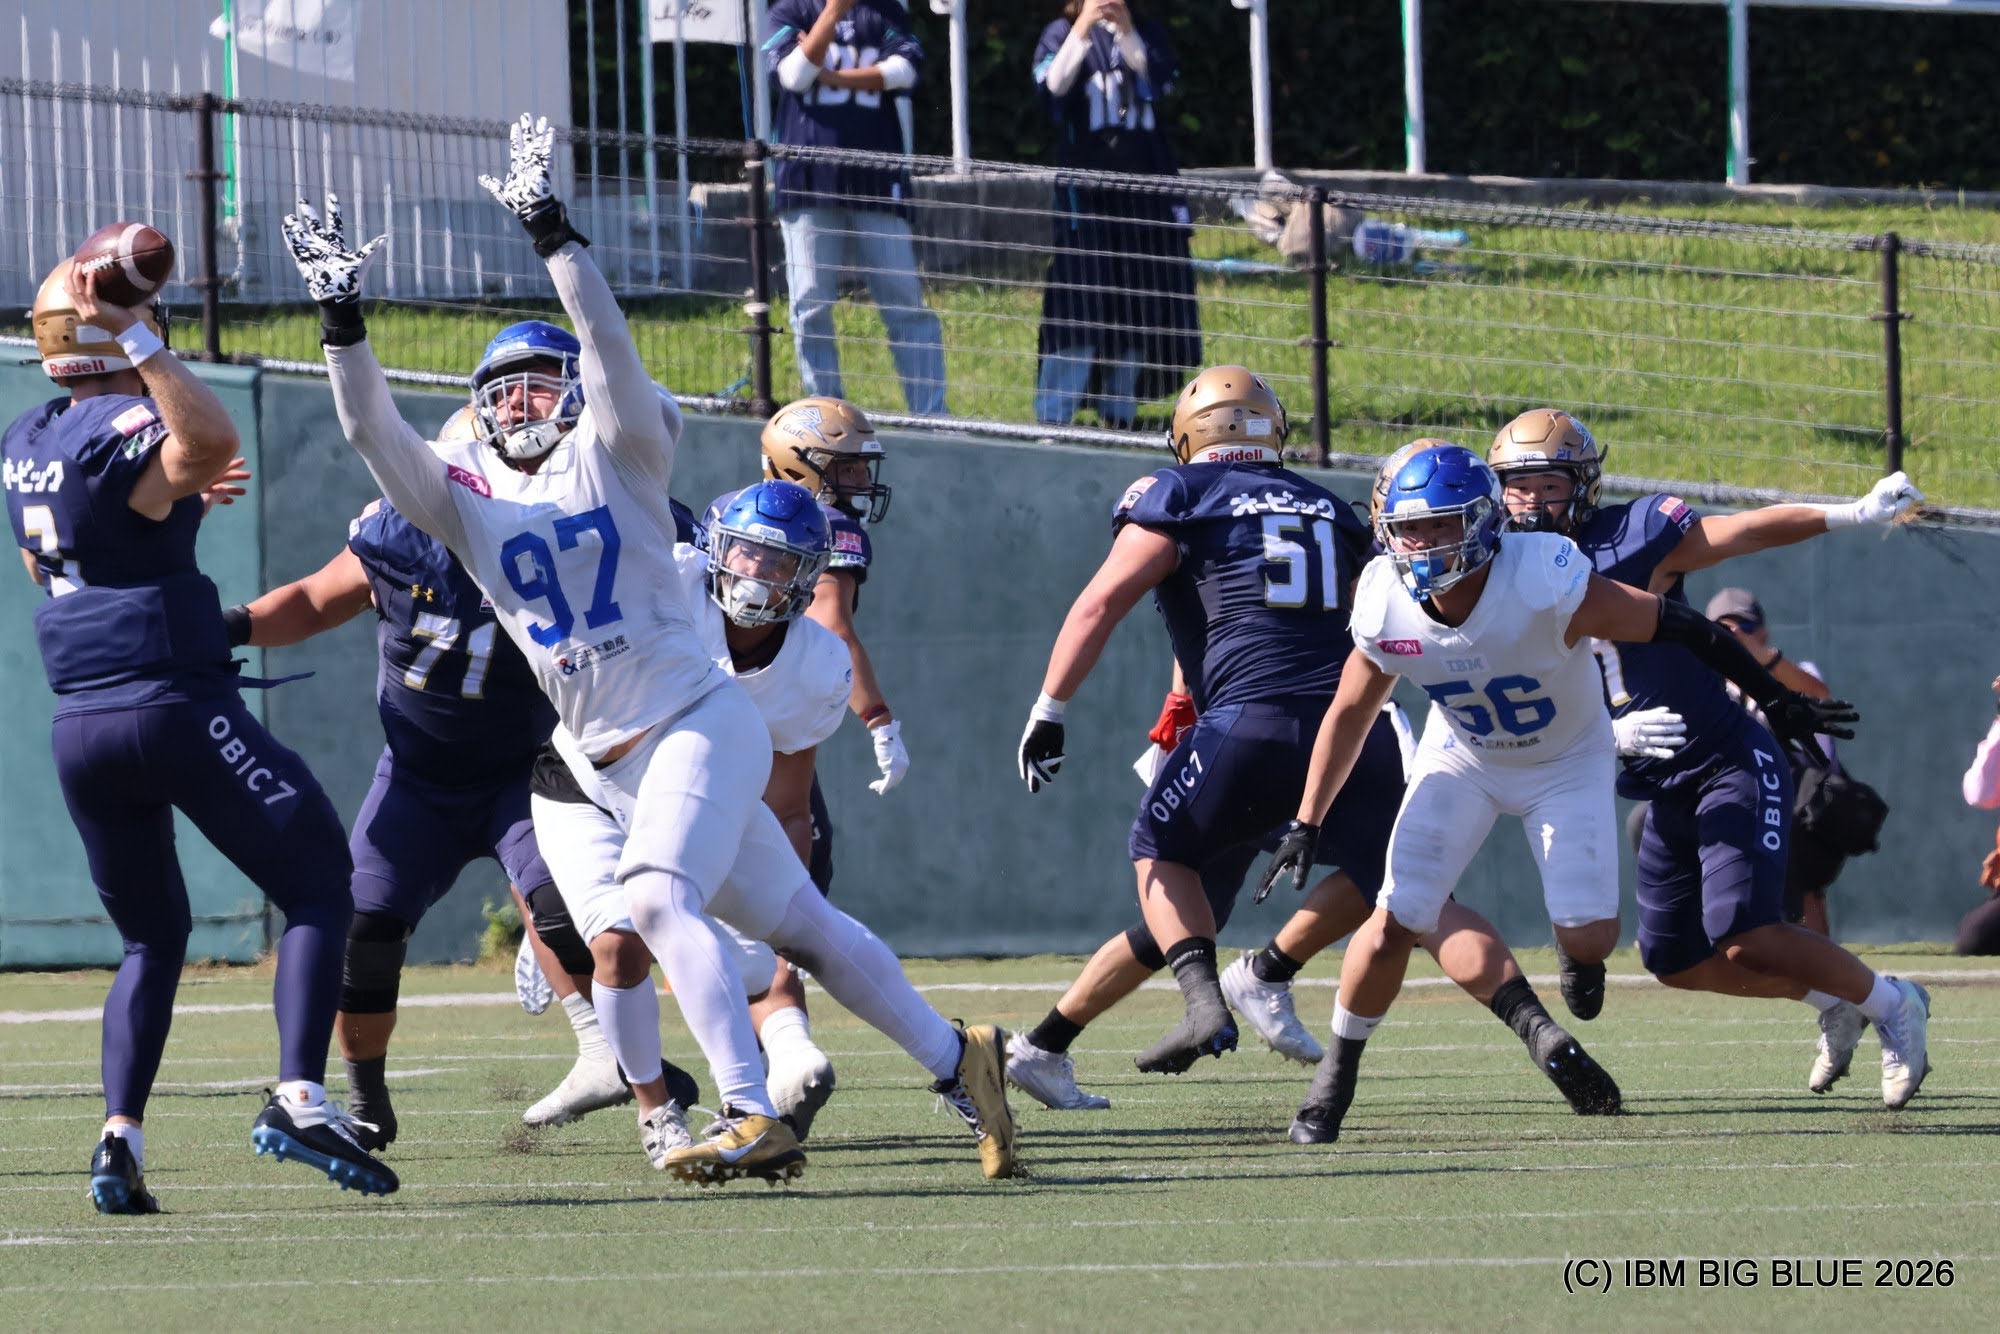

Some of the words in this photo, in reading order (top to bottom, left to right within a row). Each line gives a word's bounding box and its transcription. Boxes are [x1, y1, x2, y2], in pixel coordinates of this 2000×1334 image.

[49, 359, 106, 376] Riddell
[1208, 449, 1263, 462] Riddell
[1230, 490, 1336, 521] オービック
[500, 504, 623, 649] 97
[1262, 515, 1338, 611] 51
[404, 611, 497, 699] 71
[1446, 657, 1485, 672] IBM
[1422, 674, 1557, 736] 56
[208, 715, 298, 806] OBIC7
[1150, 749, 1203, 823] OBIC7
[1753, 748, 1781, 851] OBIC7
